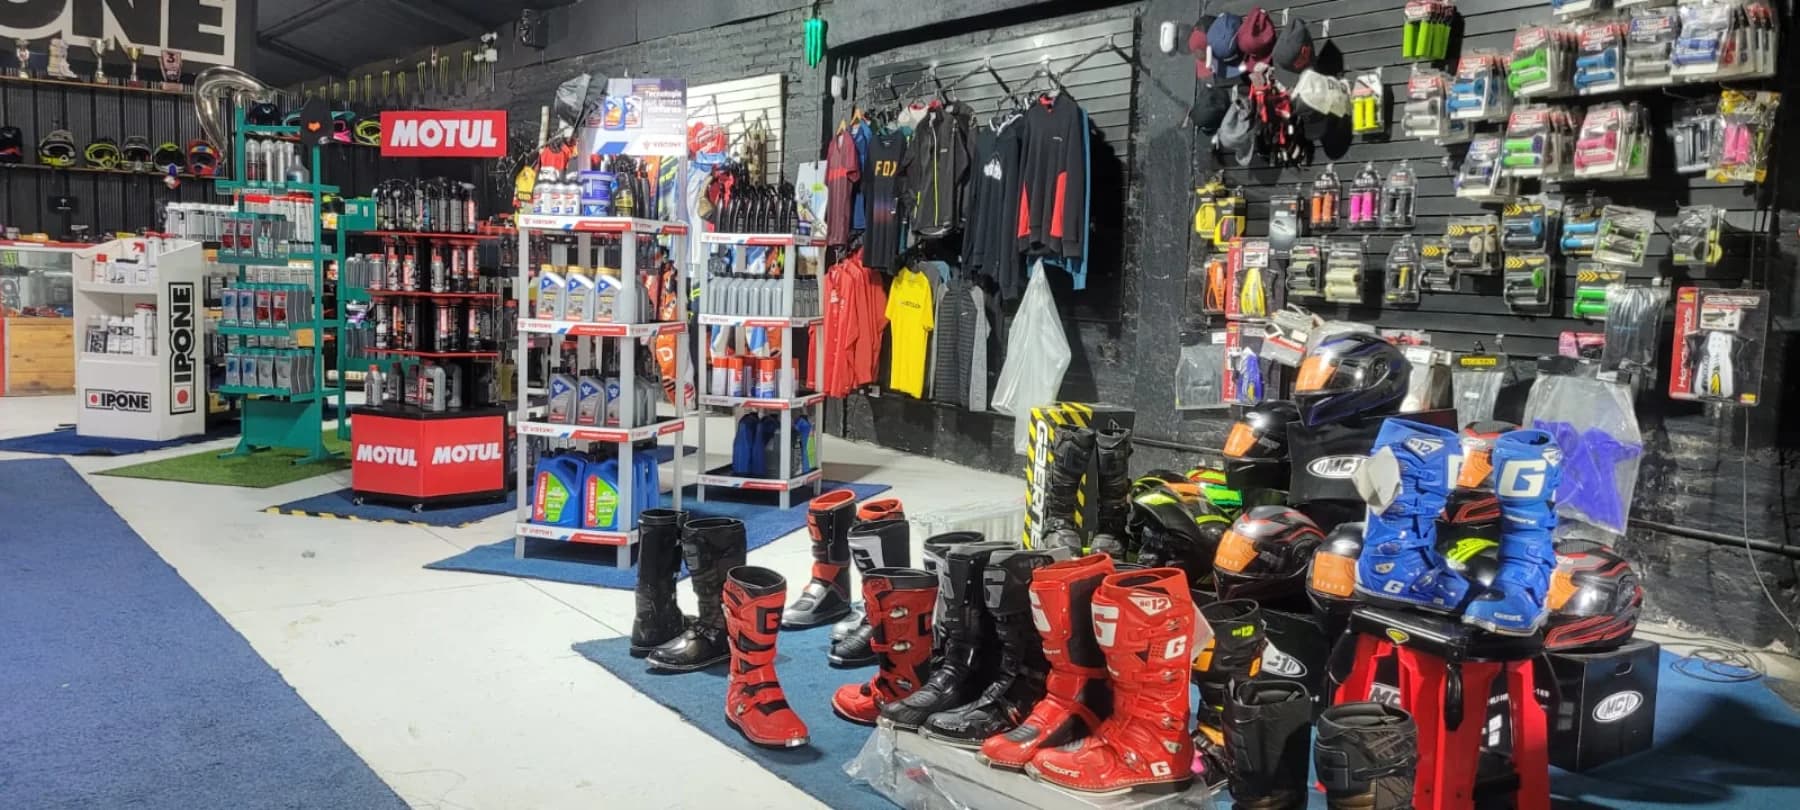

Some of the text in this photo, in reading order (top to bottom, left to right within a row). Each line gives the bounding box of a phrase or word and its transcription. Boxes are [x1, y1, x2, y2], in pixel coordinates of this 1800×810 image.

[390, 119, 498, 148] MOTUL
[173, 287, 192, 383] IPONE
[101, 393, 149, 409] IPONE
[356, 444, 418, 467] MOTUL
[432, 442, 501, 465] MOTUL
[1498, 460, 1547, 497] G
[1165, 635, 1186, 660] G
[1151, 762, 1171, 777] G
